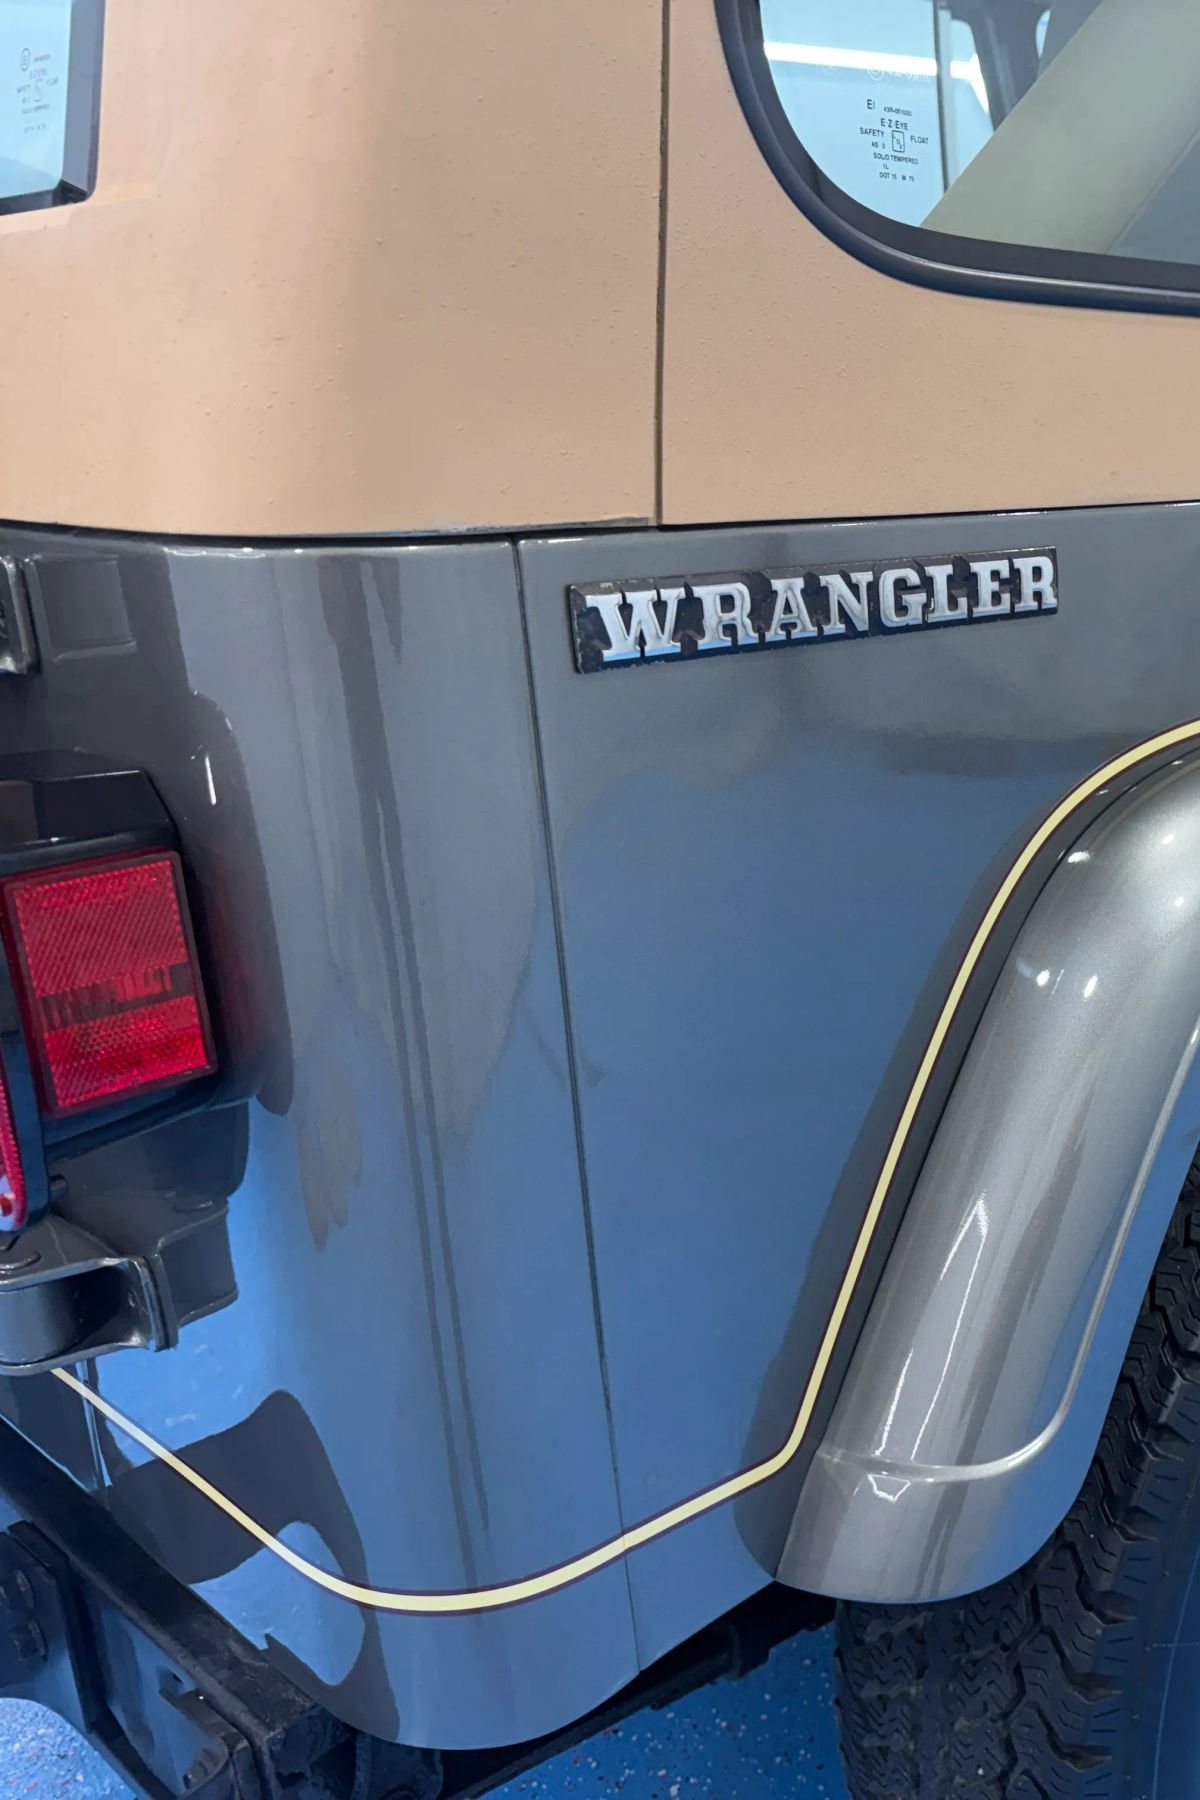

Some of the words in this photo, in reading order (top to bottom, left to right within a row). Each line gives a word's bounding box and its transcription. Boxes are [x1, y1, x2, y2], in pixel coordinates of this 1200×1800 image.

[859, 127, 885, 138] SAFETY
[910, 135, 929, 144] FLOAT
[890, 154, 919, 165] TEMPERED
[879, 171, 890, 179] DOT
[584, 555, 1058, 662] WRANGLER
